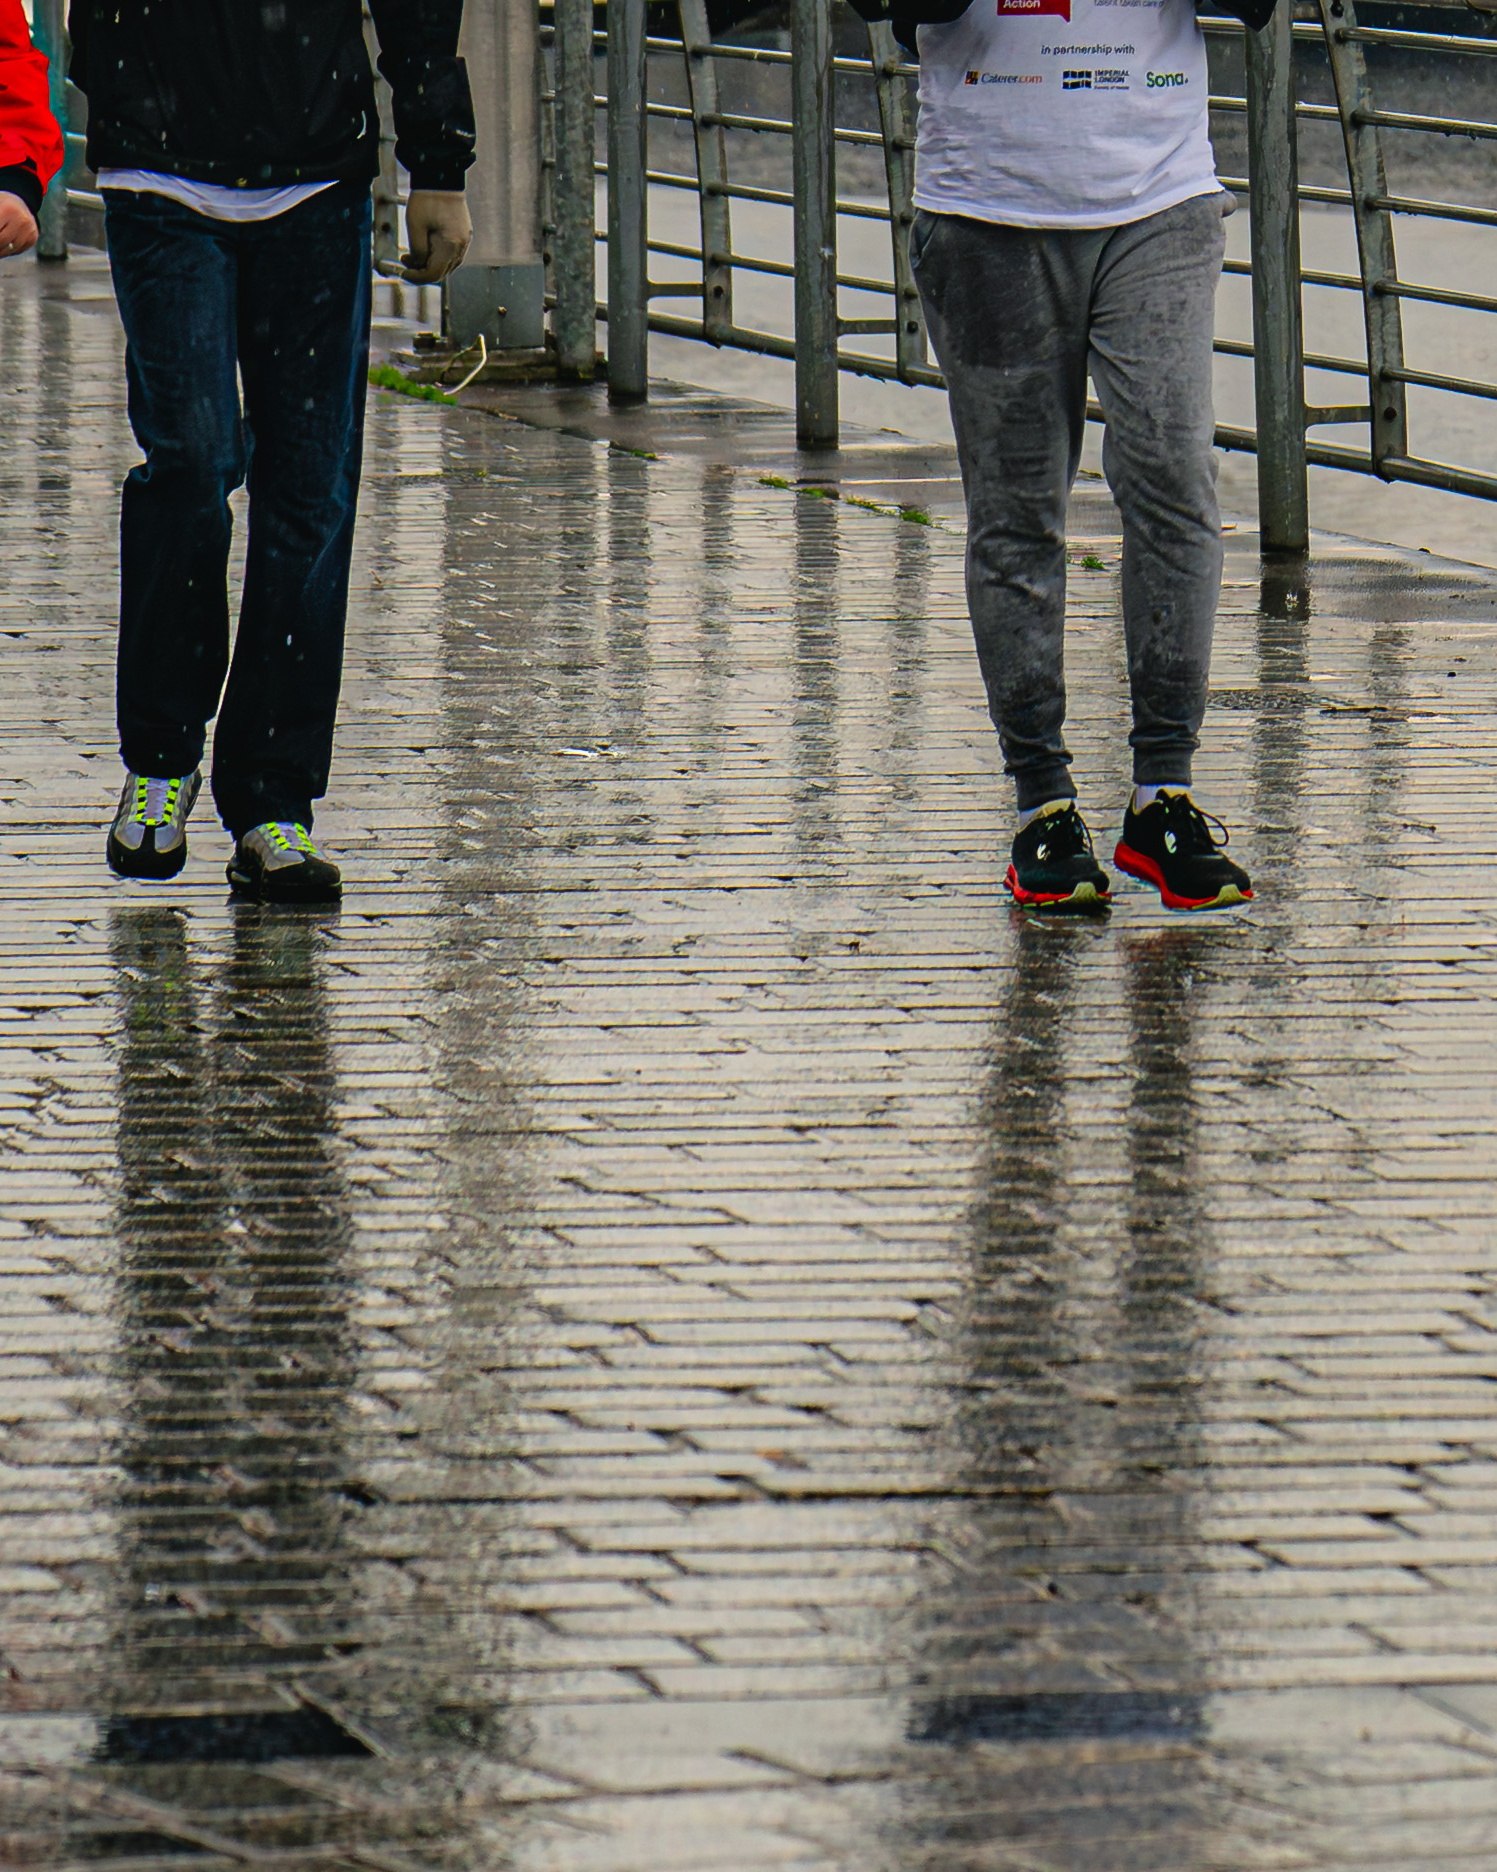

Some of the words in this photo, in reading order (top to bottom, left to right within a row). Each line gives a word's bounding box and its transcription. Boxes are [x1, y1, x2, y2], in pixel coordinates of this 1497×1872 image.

[1041, 44, 1051, 54] in
[1053, 44, 1113, 56] partnership
[1114, 44, 1136, 55] with
[981, 72, 1043, 84] Caterer.com
